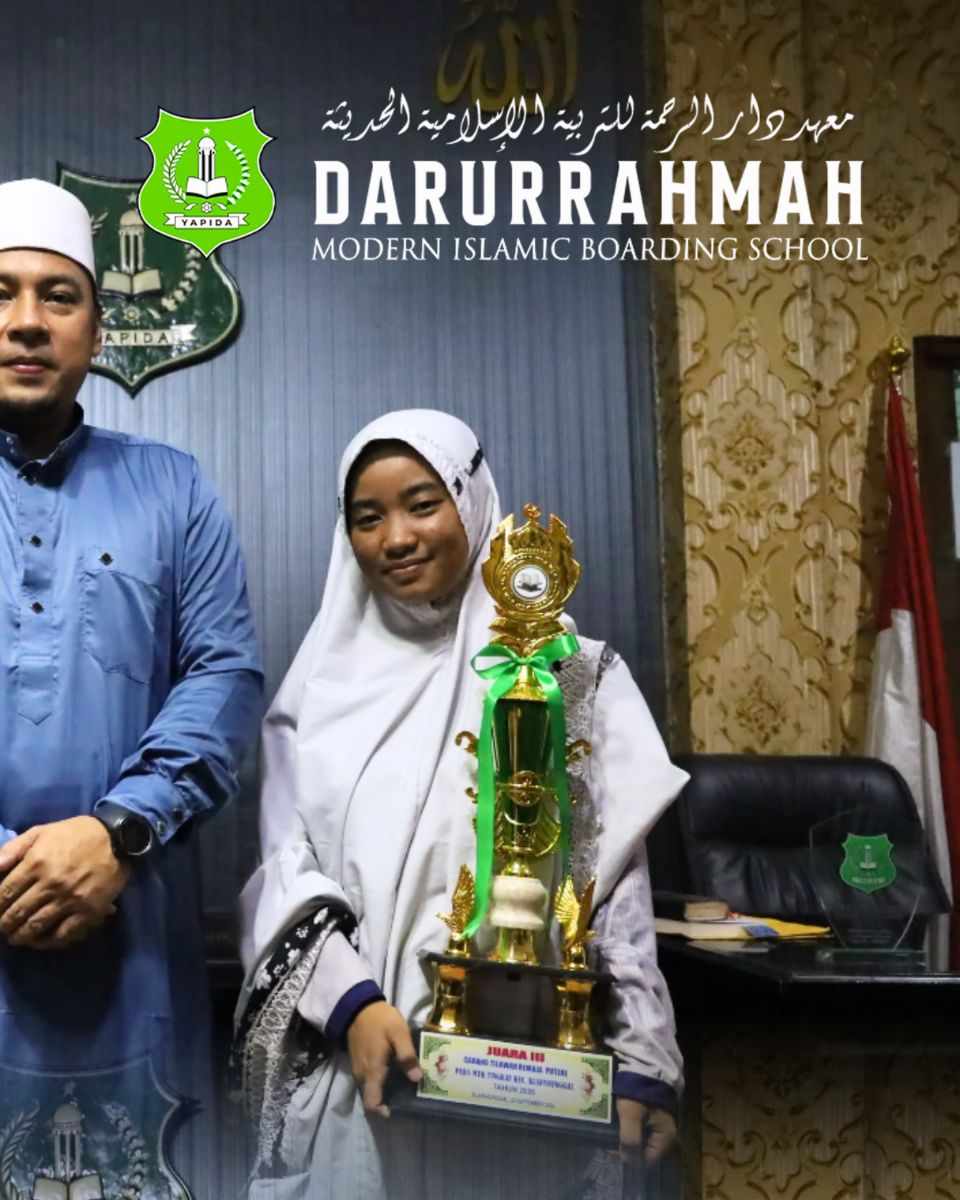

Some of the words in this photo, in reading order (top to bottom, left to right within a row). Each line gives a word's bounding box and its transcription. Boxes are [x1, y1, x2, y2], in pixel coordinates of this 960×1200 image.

[104, 332, 170, 345] APIDA
[486, 1046, 527, 1060] JUARA
[530, 1051, 545, 1062] III
